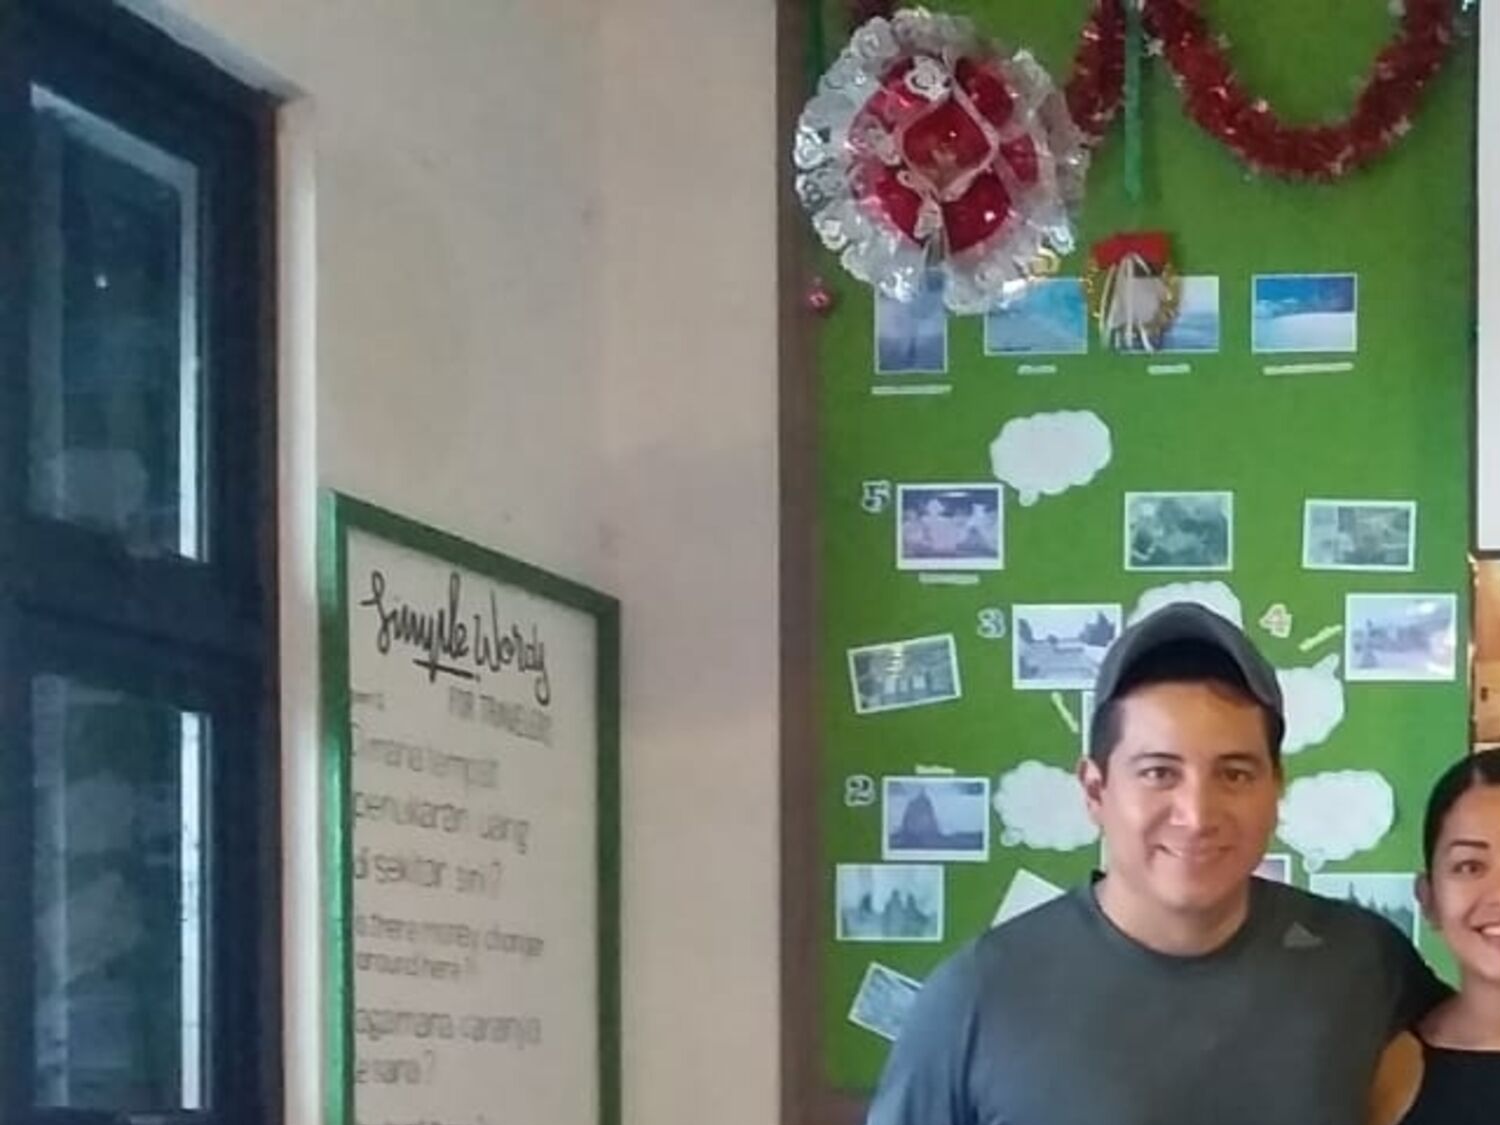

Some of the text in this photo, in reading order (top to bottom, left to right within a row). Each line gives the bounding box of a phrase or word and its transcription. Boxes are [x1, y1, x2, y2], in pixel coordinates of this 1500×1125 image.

[861, 479, 891, 513] 5
[976, 607, 1006, 639] 3
[1259, 603, 1292, 638] 4
[844, 774, 876, 807] 2
